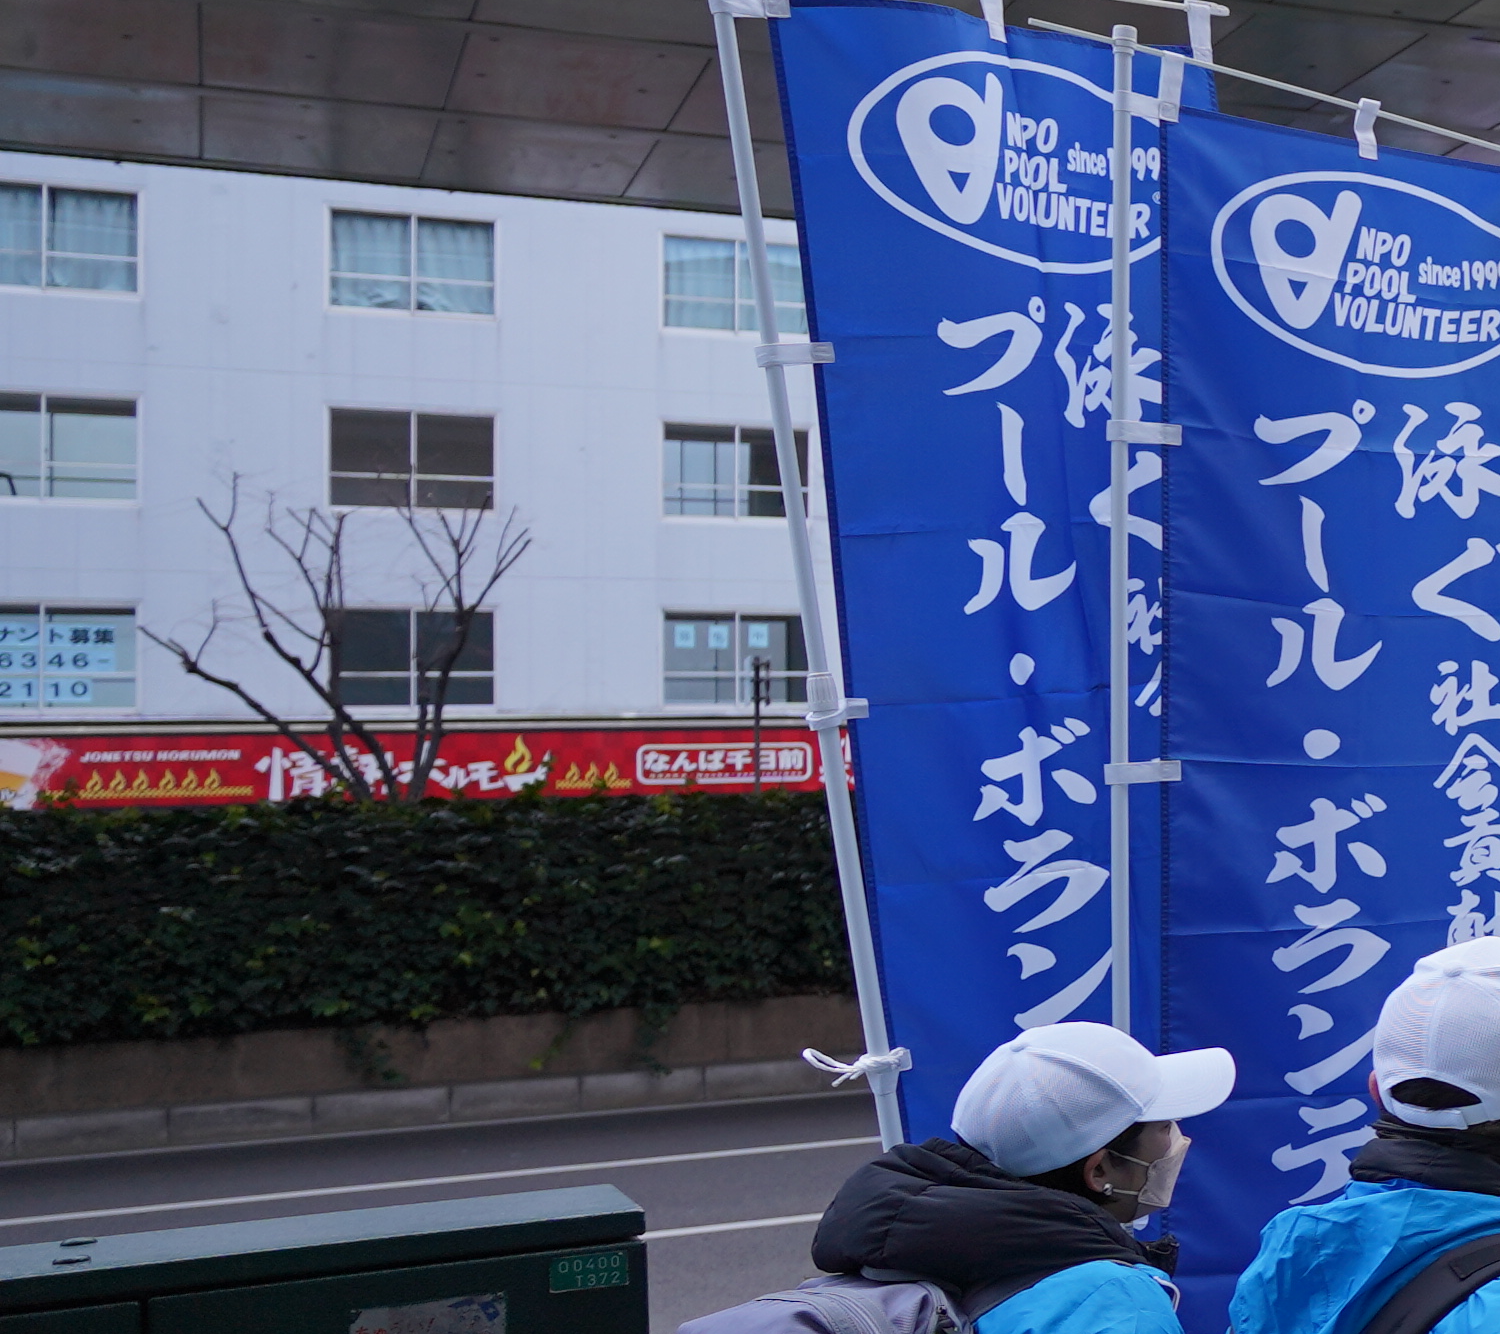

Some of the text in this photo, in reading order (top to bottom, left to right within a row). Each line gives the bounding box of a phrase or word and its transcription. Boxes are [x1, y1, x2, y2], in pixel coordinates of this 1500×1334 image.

[1006, 111, 1059, 154] NPO
[1003, 148, 1069, 194] POOL
[1356, 225, 1412, 267] NPO
[1345, 262, 1417, 304] POOL
[643, 748, 805, 771] なんば千日前
[575, 1271, 621, 1288] T372
